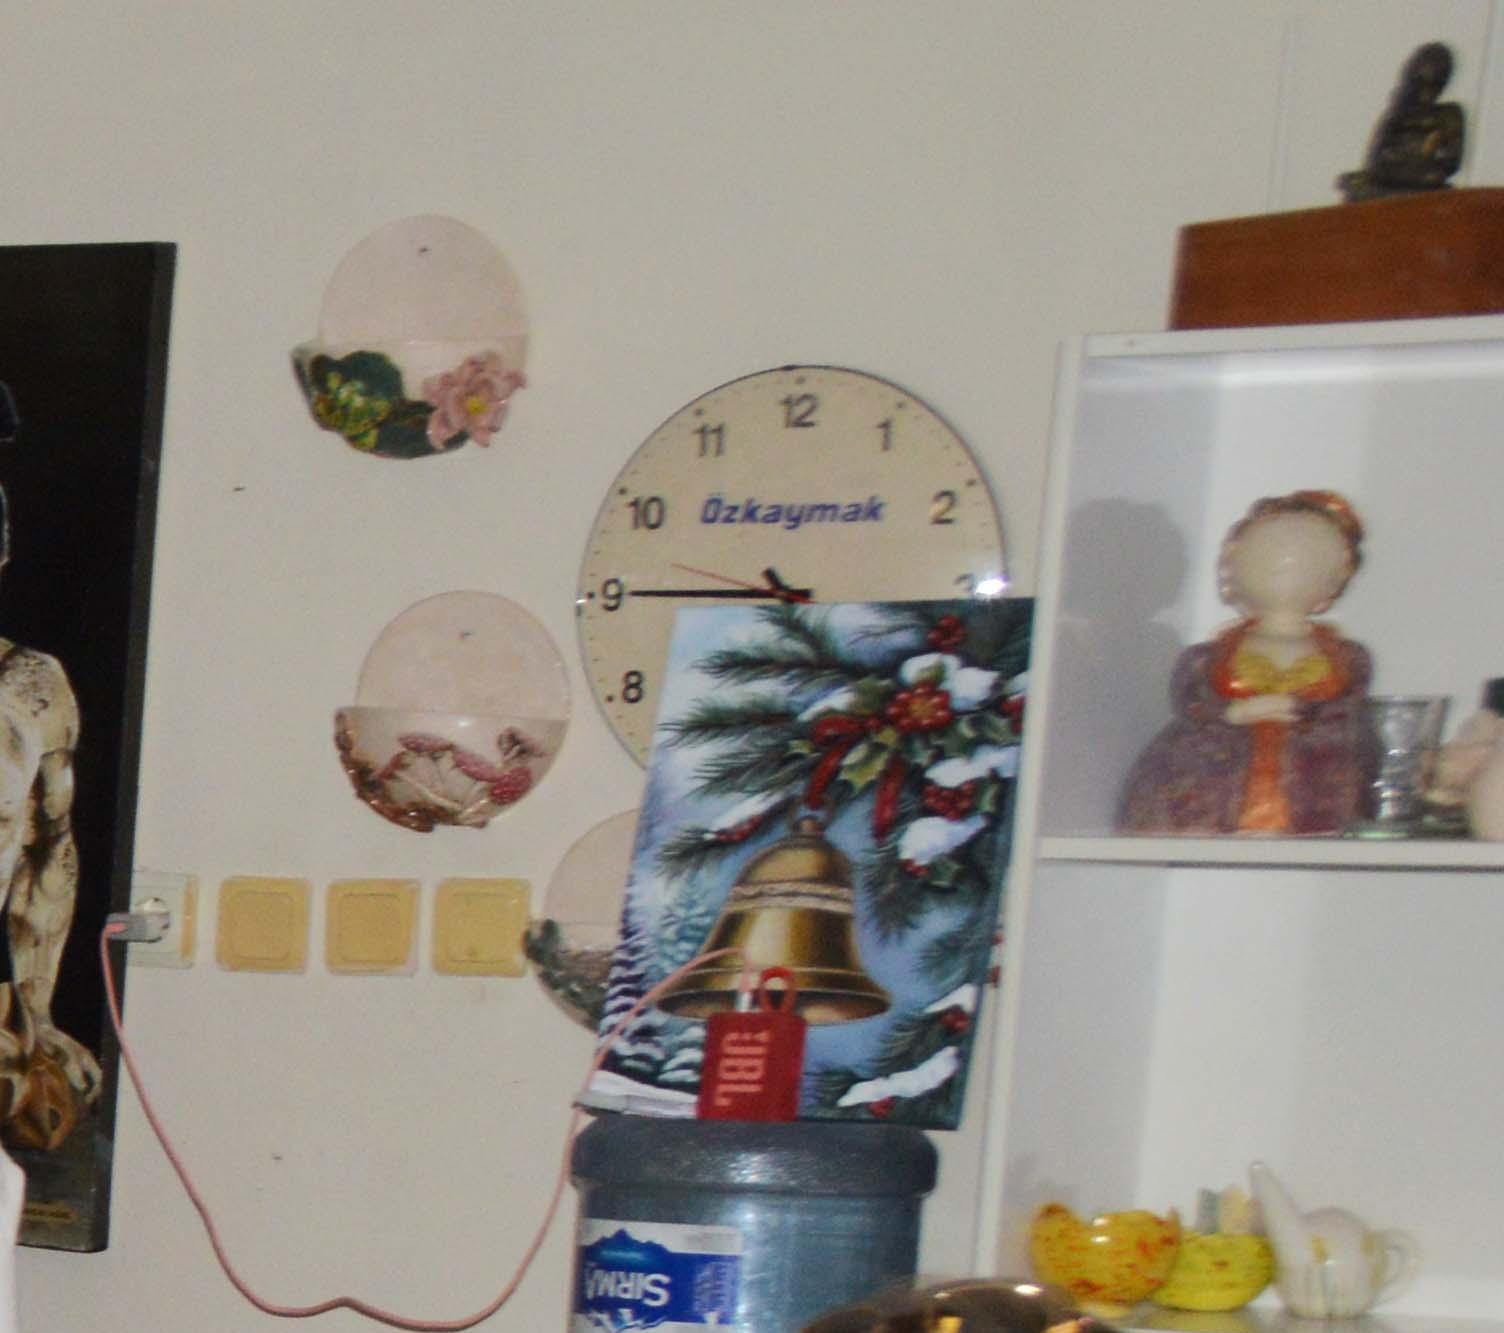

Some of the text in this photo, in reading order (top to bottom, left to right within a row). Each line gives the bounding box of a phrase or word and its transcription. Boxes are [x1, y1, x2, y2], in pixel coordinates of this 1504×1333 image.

[779, 393, 819, 428] 12
[692, 423, 726, 457] 11
[877, 418, 893, 451] 1
[627, 496, 665, 530] 10
[700, 491, 884, 531] Özkaymak
[930, 490, 956, 525] 2
[602, 578, 624, 611] 9
[621, 669, 644, 704] 8
